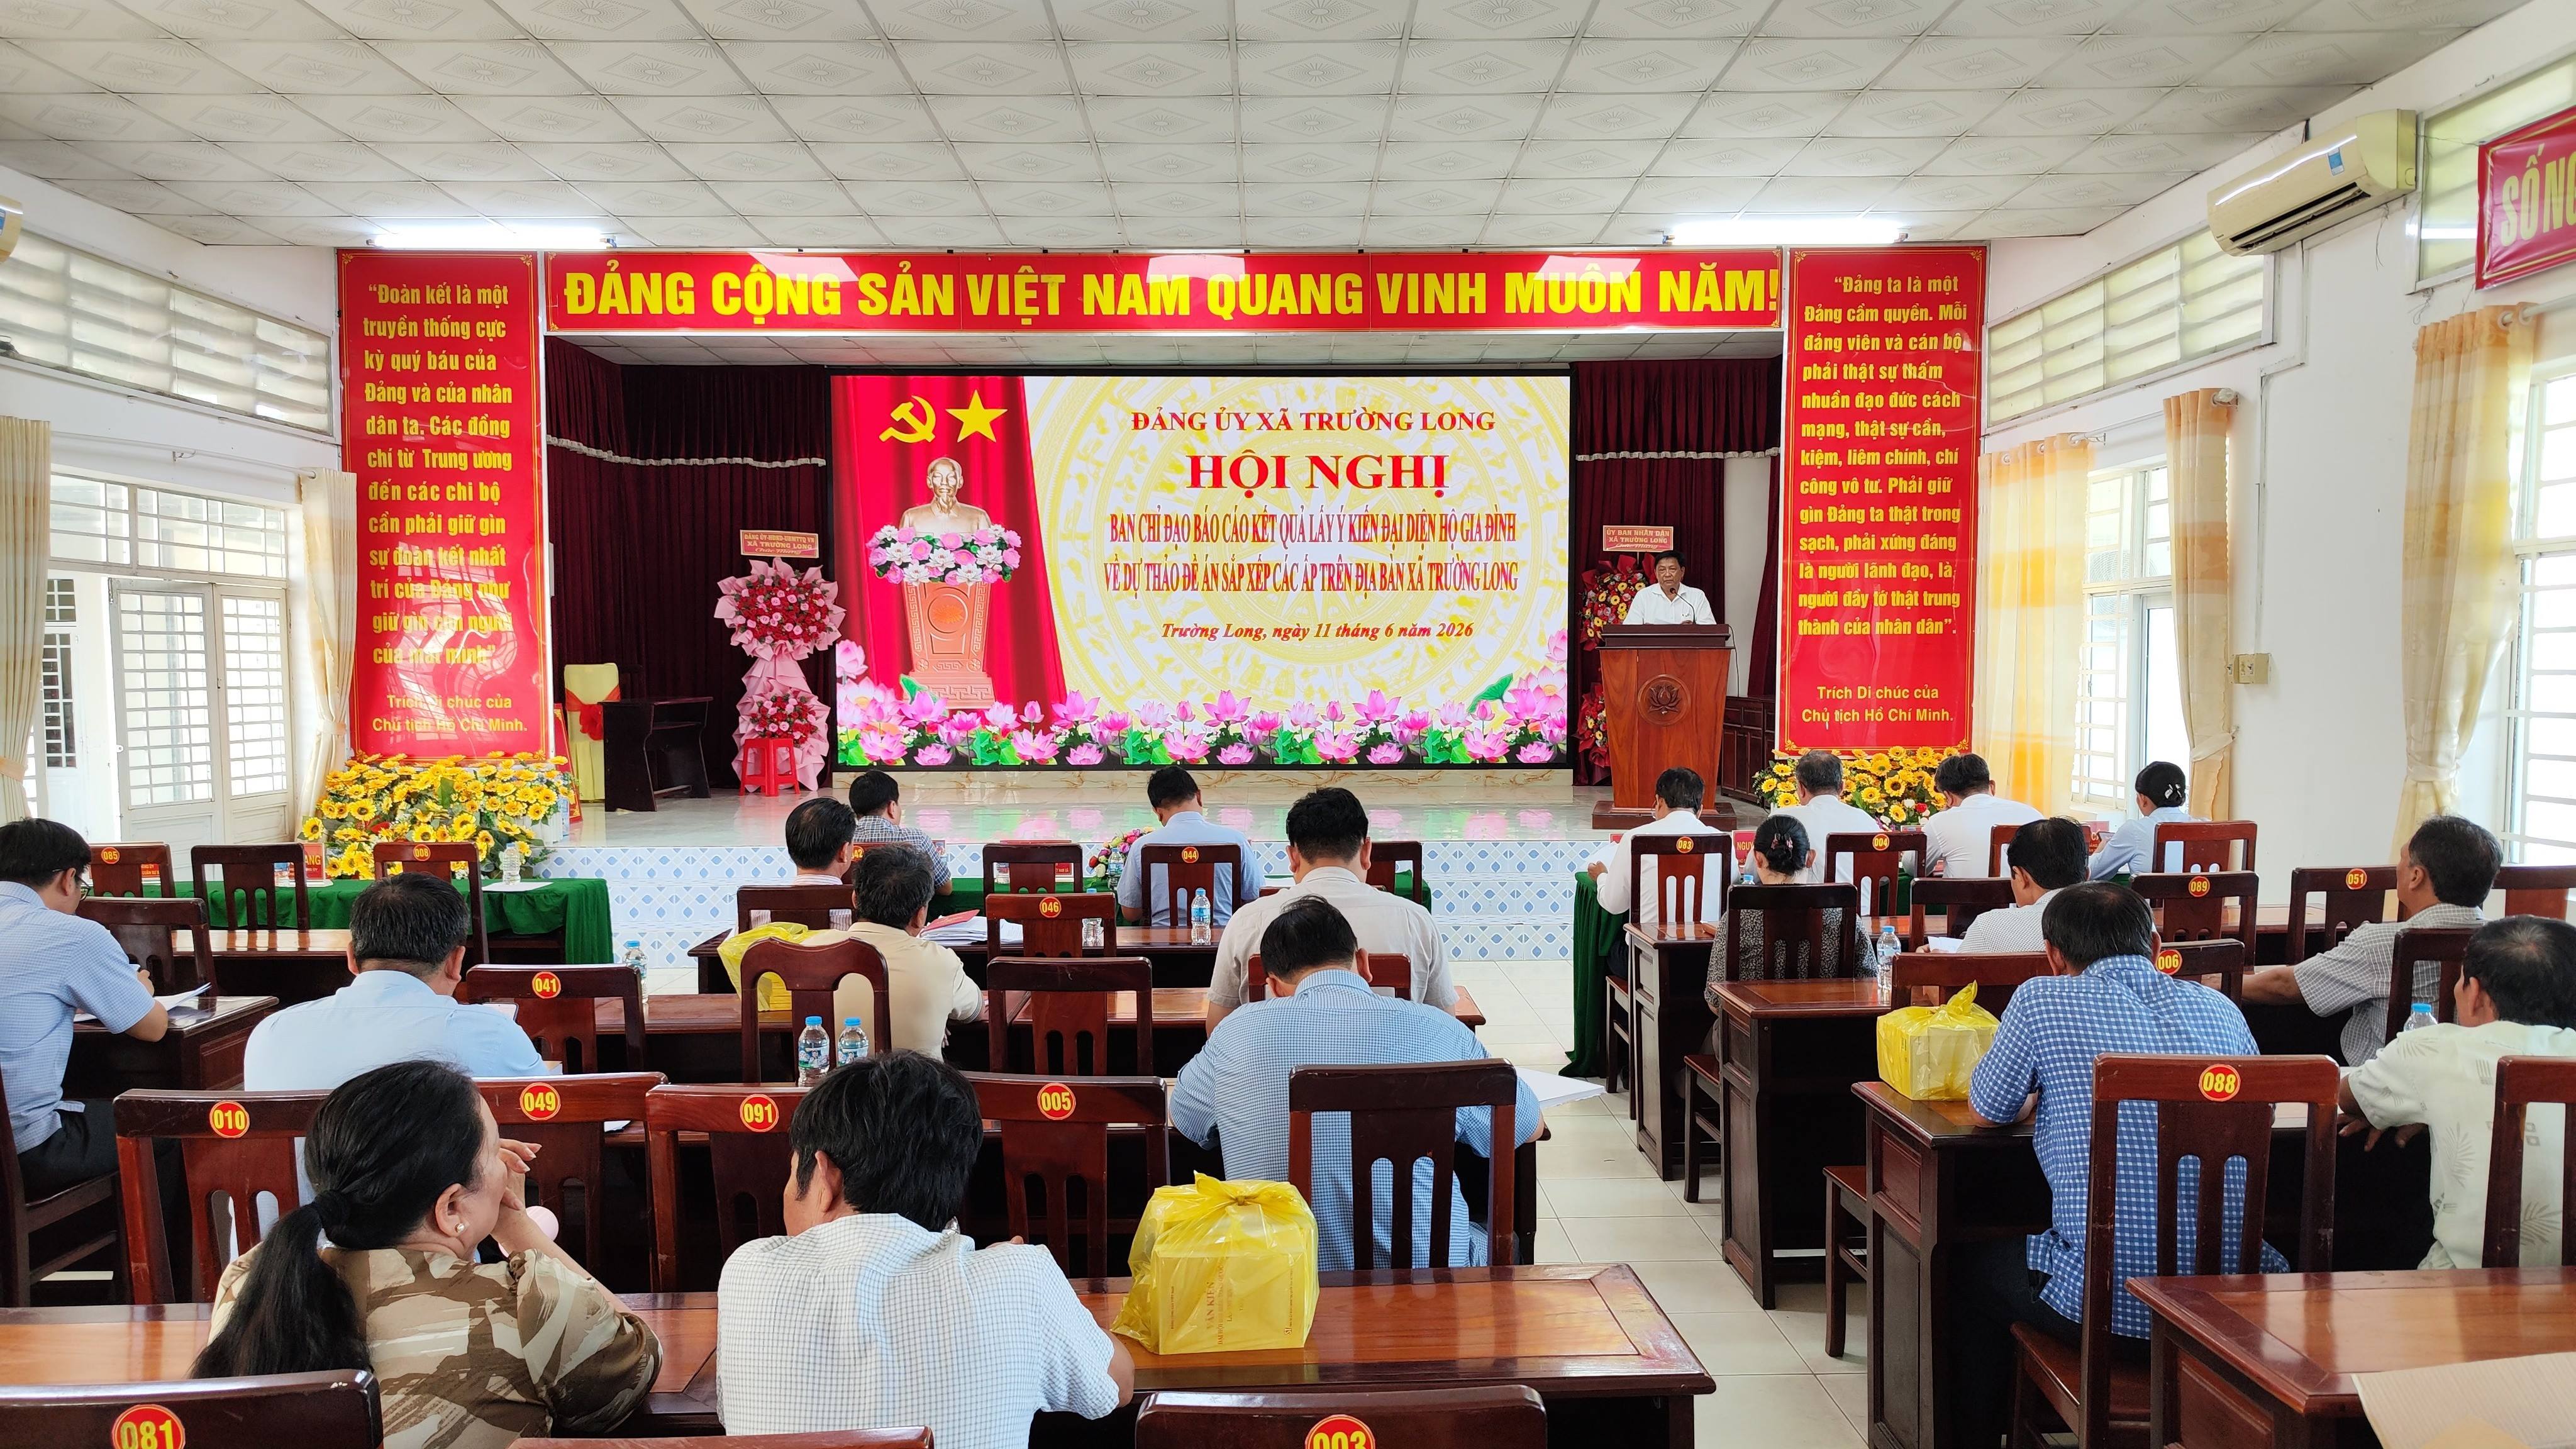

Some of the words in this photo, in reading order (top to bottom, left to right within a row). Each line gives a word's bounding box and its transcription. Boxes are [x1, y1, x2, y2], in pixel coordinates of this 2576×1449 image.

[426, 282, 451, 304] kết
[457, 284, 471, 304] là
[478, 285, 508, 308] một
[565, 259, 695, 316] ĐẢNG
[711, 264, 841, 325] CỘNG
[858, 260, 954, 316] SẢN
[965, 265, 1065, 325] VIỆT
[1083, 273, 1190, 316] NAM
[1207, 273, 1364, 321] QUANG
[1376, 272, 1487, 314] VINH
[1504, 263, 1641, 314] MUÔN
[1658, 261, 1779, 313] NĂM!
[1887, 278, 1901, 292] ta
[1907, 277, 1922, 292] là
[1928, 276, 1958, 295] một
[1804, 304, 1842, 323] Đảng
[1847, 303, 1879, 322] cầm
[1884, 303, 1933, 324] quyền.
[1939, 301, 1967, 321] Mỗi
[364, 315, 418, 338] truyền
[424, 315, 470, 340] thống
[476, 318, 506, 341] cực
[1804, 333, 1842, 352] đảng
[1847, 336, 1880, 350] viên
[1885, 335, 1902, 350] và
[1909, 335, 1938, 350] cán
[1943, 333, 1962, 353] bộ
[365, 350, 384, 371] kỳ
[391, 350, 421, 372] quý
[428, 350, 458, 370] báu
[465, 349, 496, 370] của
[1803, 361, 1837, 381] phải
[1843, 364, 1874, 383] thật
[1879, 364, 1899, 382] sự
[1902, 360, 1942, 379] thấm
[365, 380, 406, 404] Đảng
[412, 383, 430, 402] và
[436, 381, 465, 402] của
[472, 384, 512, 403] nhân
[1802, 390, 1850, 409] nhuần
[1855, 392, 1884, 411] đạo
[1889, 391, 1916, 408] đức
[1923, 391, 1960, 408] cách
[366, 416, 397, 435] dân
[402, 417, 424, 435] ta.
[430, 416, 462, 435] Các
[468, 414, 509, 438] đồng
[1131, 407, 1207, 431] ĐẢNG
[1214, 407, 1253, 431] ỦY
[1257, 408, 1293, 431] XÃ
[1299, 406, 1414, 431] TRƯỜNG
[1420, 412, 1496, 431] LONG
[368, 449, 392, 468] chí
[398, 449, 414, 468] từ
[423, 449, 468, 470] Trung
[473, 450, 512, 470] ương
[1185, 449, 1291, 498] HỘI
[1305, 454, 1450, 498] NGHỊ
[369, 479, 401, 501] đến
[408, 482, 440, 501] các
[446, 482, 472, 501] chi
[479, 482, 500, 505] bộ
[1110, 513, 1136, 543] BAN
[1138, 504, 1162, 543] CHỈ
[1164, 513, 1191, 551] ĐẠO
[1194, 505, 1219, 543] BÁO
[1222, 505, 1249, 543] CÁO
[1252, 505, 1277, 543] KẾT
[1280, 505, 1306, 550] QUẢ
[1308, 505, 1335, 543] LẤY
[1338, 505, 1346, 543] Ý
[1348, 505, 1379, 542] KIẾN
[1381, 513, 1404, 550] ĐẠI
[1406, 509, 1437, 550] DIỆN
[1439, 509, 1458, 550] HỘ
[1460, 513, 1483, 542] GIA
[1485, 504, 1516, 541] ĐÌNH
[1104, 553, 1120, 592] VỀ
[1123, 558, 1143, 599] DỰ
[1144, 553, 1179, 592] THẢO
[1182, 553, 1199, 592] ĐỀ
[1202, 553, 1219, 592] ÁN
[1222, 553, 1245, 592] SẮP
[1246, 553, 1270, 592] XẾP
[1273, 553, 1299, 592] CÁC
[1302, 553, 1317, 592] ẤP
[1319, 553, 1352, 592] TRÊN
[1355, 562, 1377, 599] ĐỊA
[1379, 553, 1405, 591] BÀN
[1407, 555, 1424, 591] XÃ
[1428, 553, 1480, 591] TRƯỜNG
[1482, 562, 1518, 591] LONG
[1162, 622, 1219, 641] Trường
[1223, 623, 1267, 641] Long,
[1272, 624, 1309, 641] ngày
[1314, 624, 1331, 638] 11
[1336, 623, 1380, 641] tháng
[1385, 623, 1394, 637] 6
[1397, 623, 1431, 637] năm
[1436, 623, 1474, 637] 2026
[1818, 686, 1852, 699] Trích
[1858, 686, 1871, 699] Di
[1875, 686, 1908, 699] chúc
[1914, 684, 1938, 699] của
[1835, 709, 1859, 724] tịch
[1865, 708, 1884, 721] Hồ
[1888, 708, 1911, 721] Chí
[1916, 708, 1953, 721] Minh.
[1679, 840, 1691, 849] 083
[1737, 841, 1754, 850] NGUY
[1874, 837, 1888, 847] 004
[103, 851, 118, 860] 085
[415, 848, 429, 857] 008
[852, 849, 863, 858] 42
[1183, 850, 1199, 860] 044
[2190, 880, 2208, 892] 089
[2348, 874, 2366, 885] 051
[1041, 902, 1060, 913] 046
[2158, 955, 2180, 970] 006
[534, 978, 558, 992] 041
[2202, 1074, 2237, 1093] 088
[524, 1092, 556, 1111] 049
[1041, 1091, 1071, 1113] 005
[213, 1110, 245, 1130] 010
[743, 1103, 774, 1123] 091
[120, 1420, 174, 1449] 081
